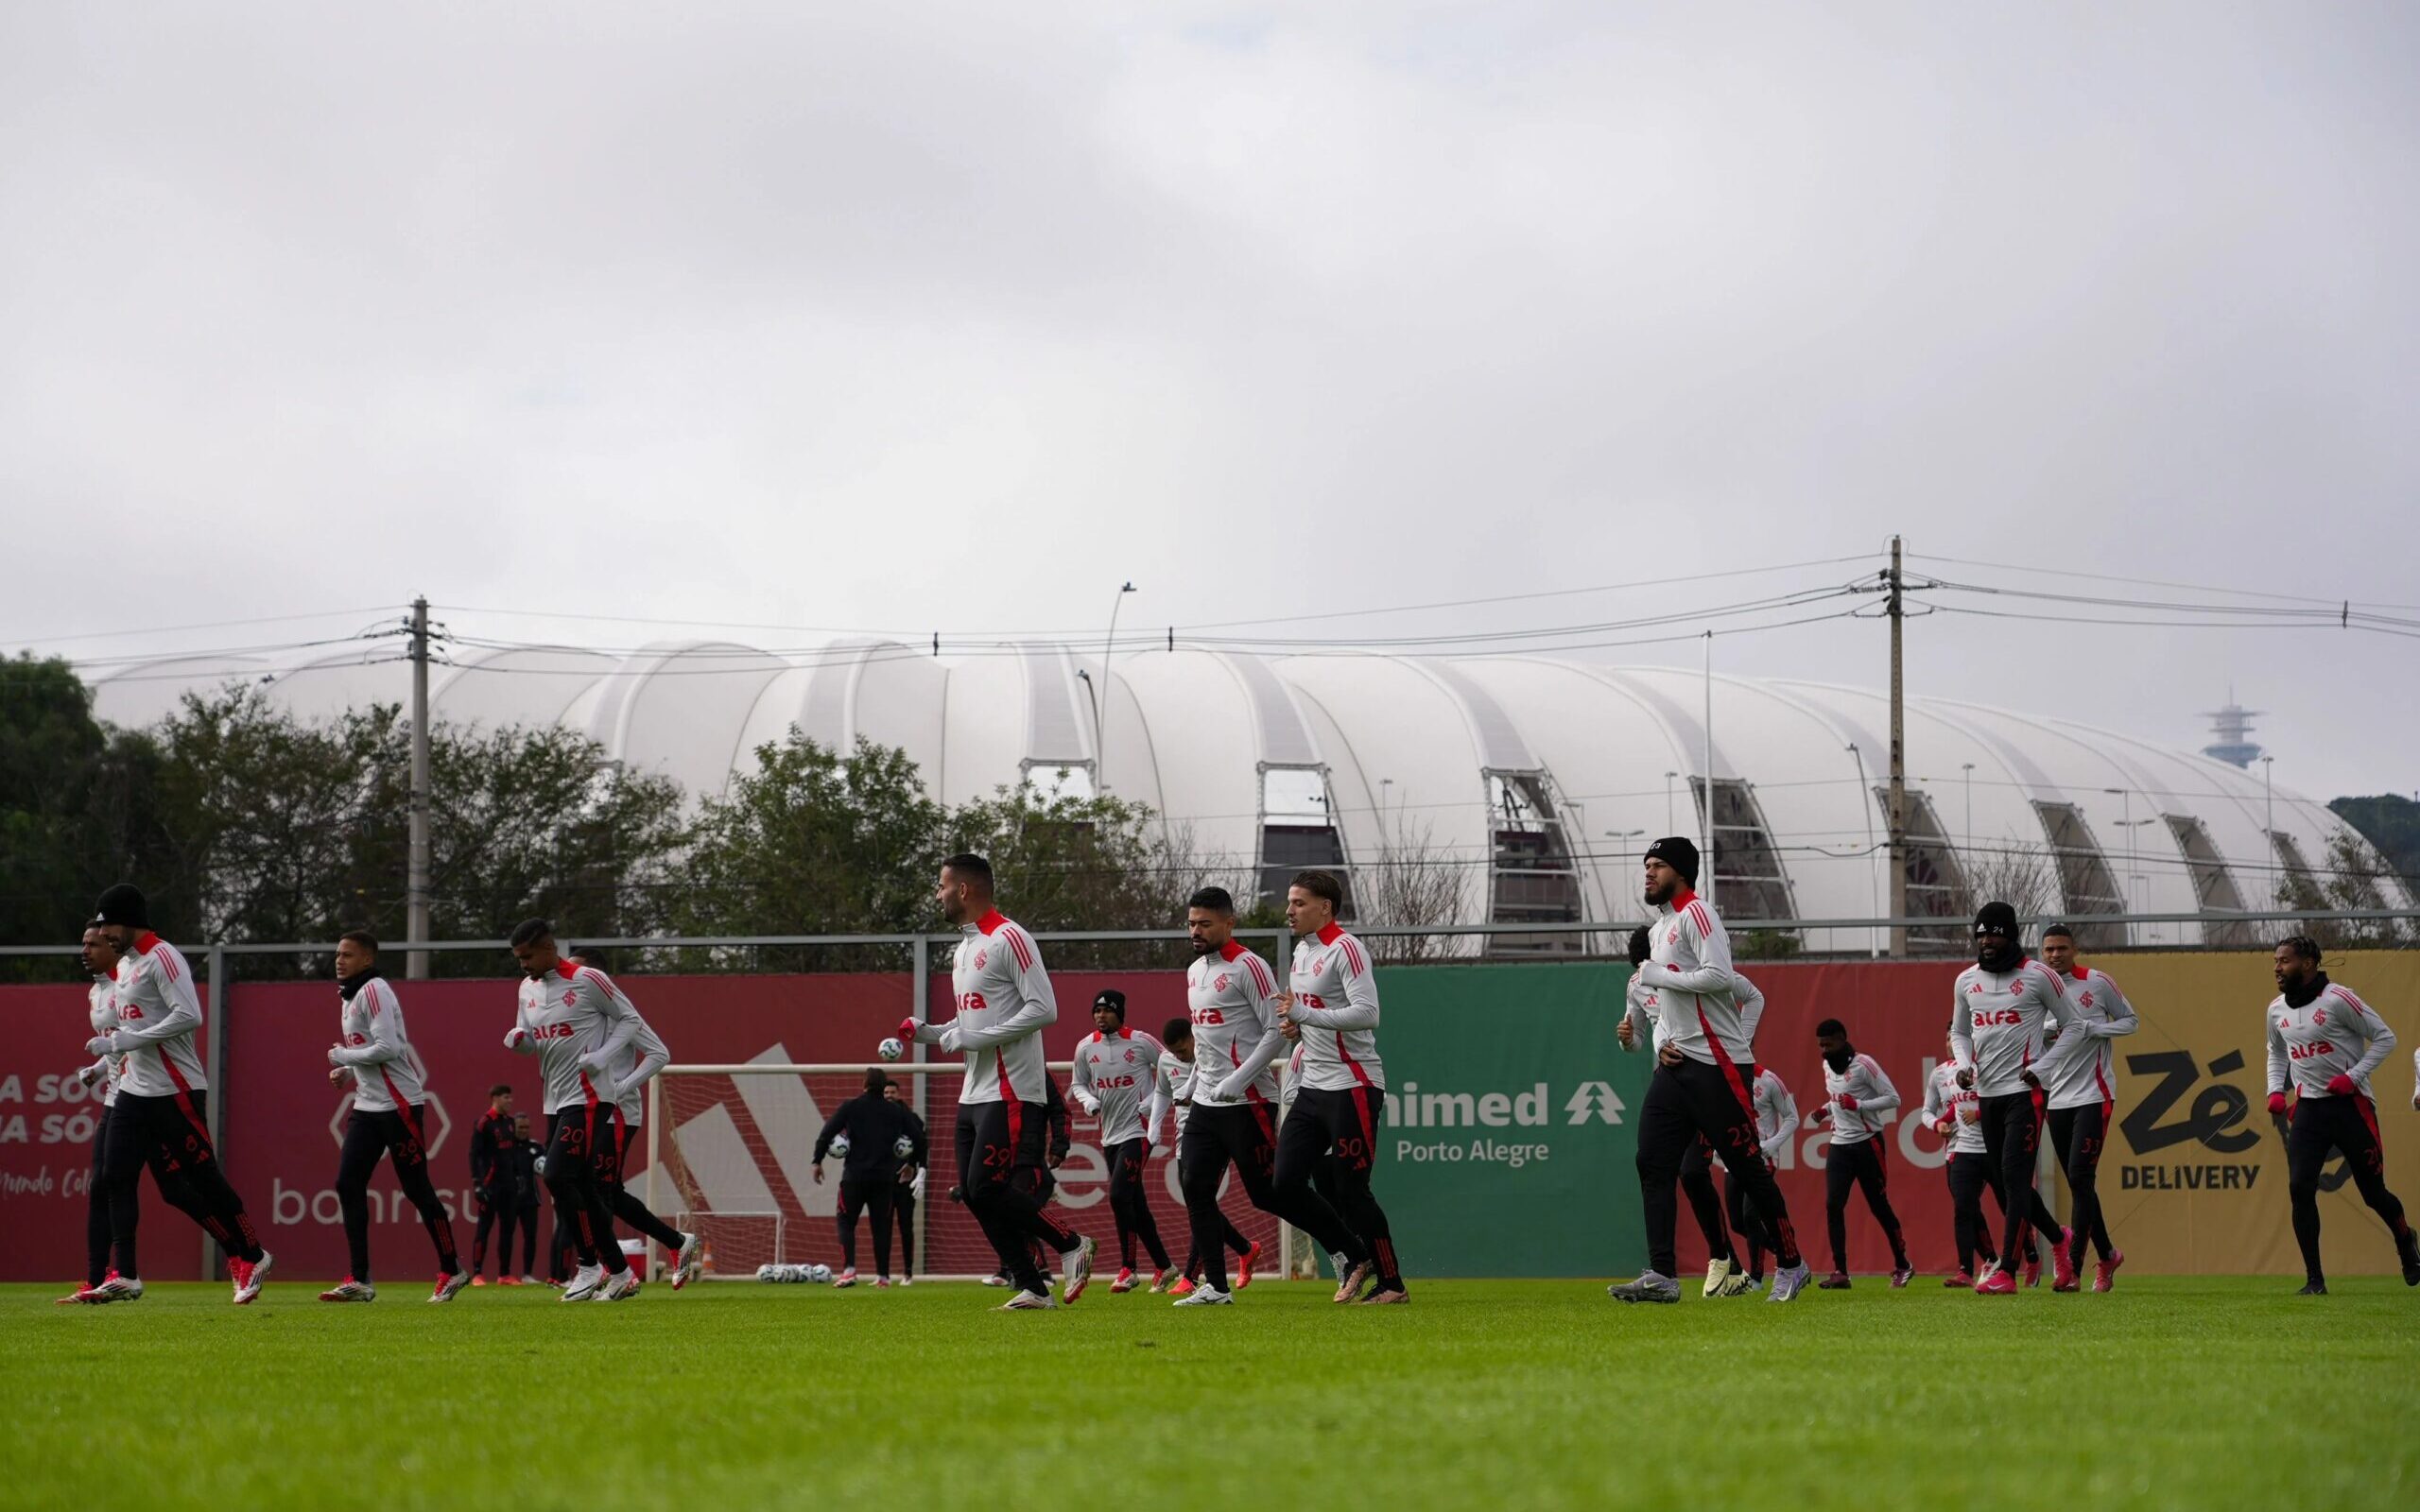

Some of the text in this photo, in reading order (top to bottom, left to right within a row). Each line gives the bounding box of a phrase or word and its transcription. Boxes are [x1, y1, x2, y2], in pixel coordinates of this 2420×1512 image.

[1993, 925, 2003, 935] 24
[1296, 992, 1325, 1008] fa
[1974, 1010, 2023, 1027] alfa
[533, 1022, 575, 1040] alfa
[2290, 1040, 2334, 1059] alfa
[1097, 1075, 1134, 1089] alfa
[2119, 1049, 2261, 1156] Zé
[0, 1115, 28, 1143] A
[560, 1126, 584, 1142] 20
[983, 1144, 1011, 1166] 29
[1339, 1138, 1362, 1158] 50
[1397, 1138, 1549, 1168] Porto Alegre
